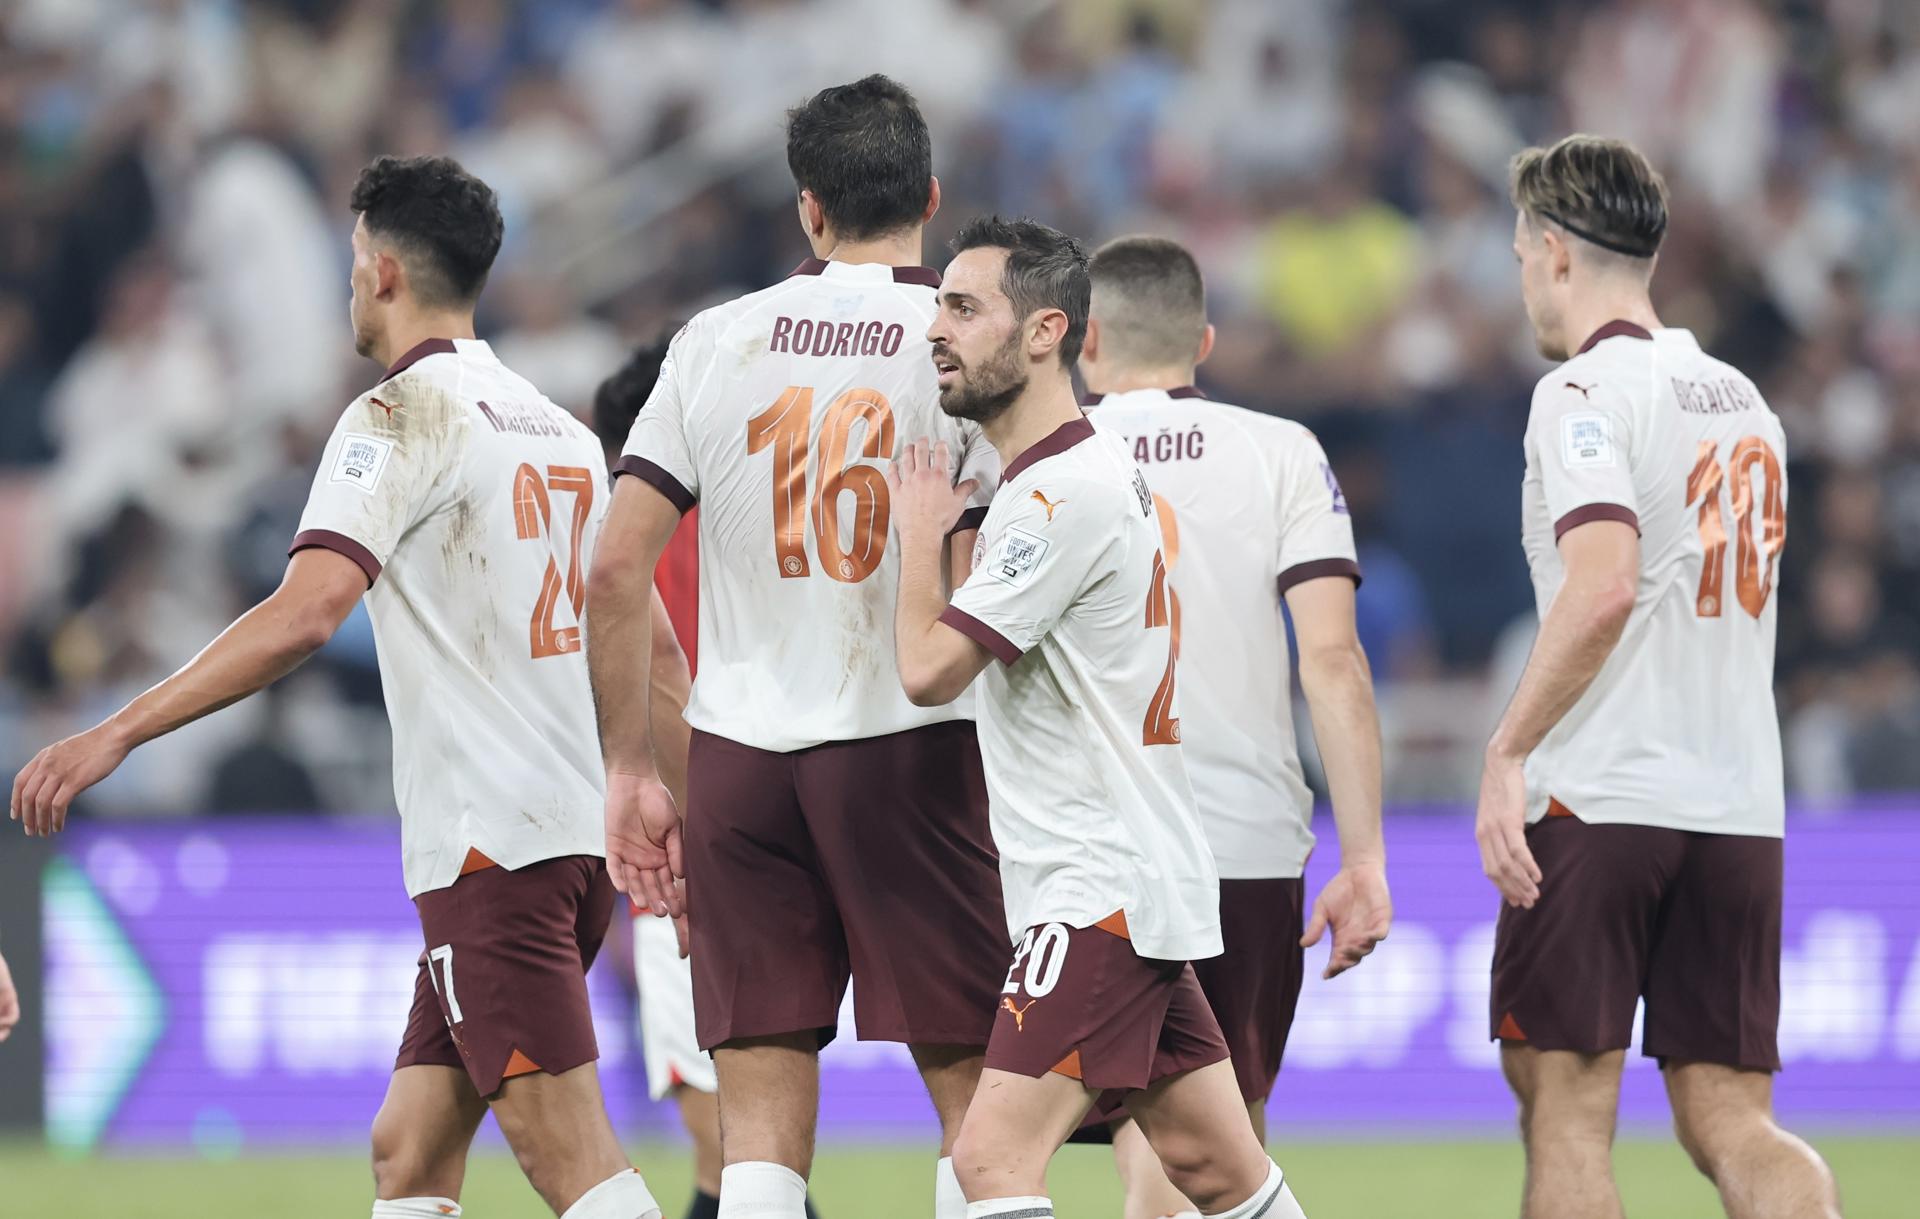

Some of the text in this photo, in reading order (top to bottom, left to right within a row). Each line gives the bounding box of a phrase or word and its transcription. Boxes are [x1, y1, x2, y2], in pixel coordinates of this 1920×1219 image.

[770, 316, 904, 357] RODRIGO
[347, 449, 376, 464] UNITES
[1123, 422, 1204, 464] AČIĆ
[746, 386, 896, 584] 16
[513, 462, 593, 659] 27
[1007, 544, 1033, 563] UNITES
[1685, 436, 1786, 619] 10
[426, 944, 463, 1028] 7
[1001, 922, 1070, 997] 20
